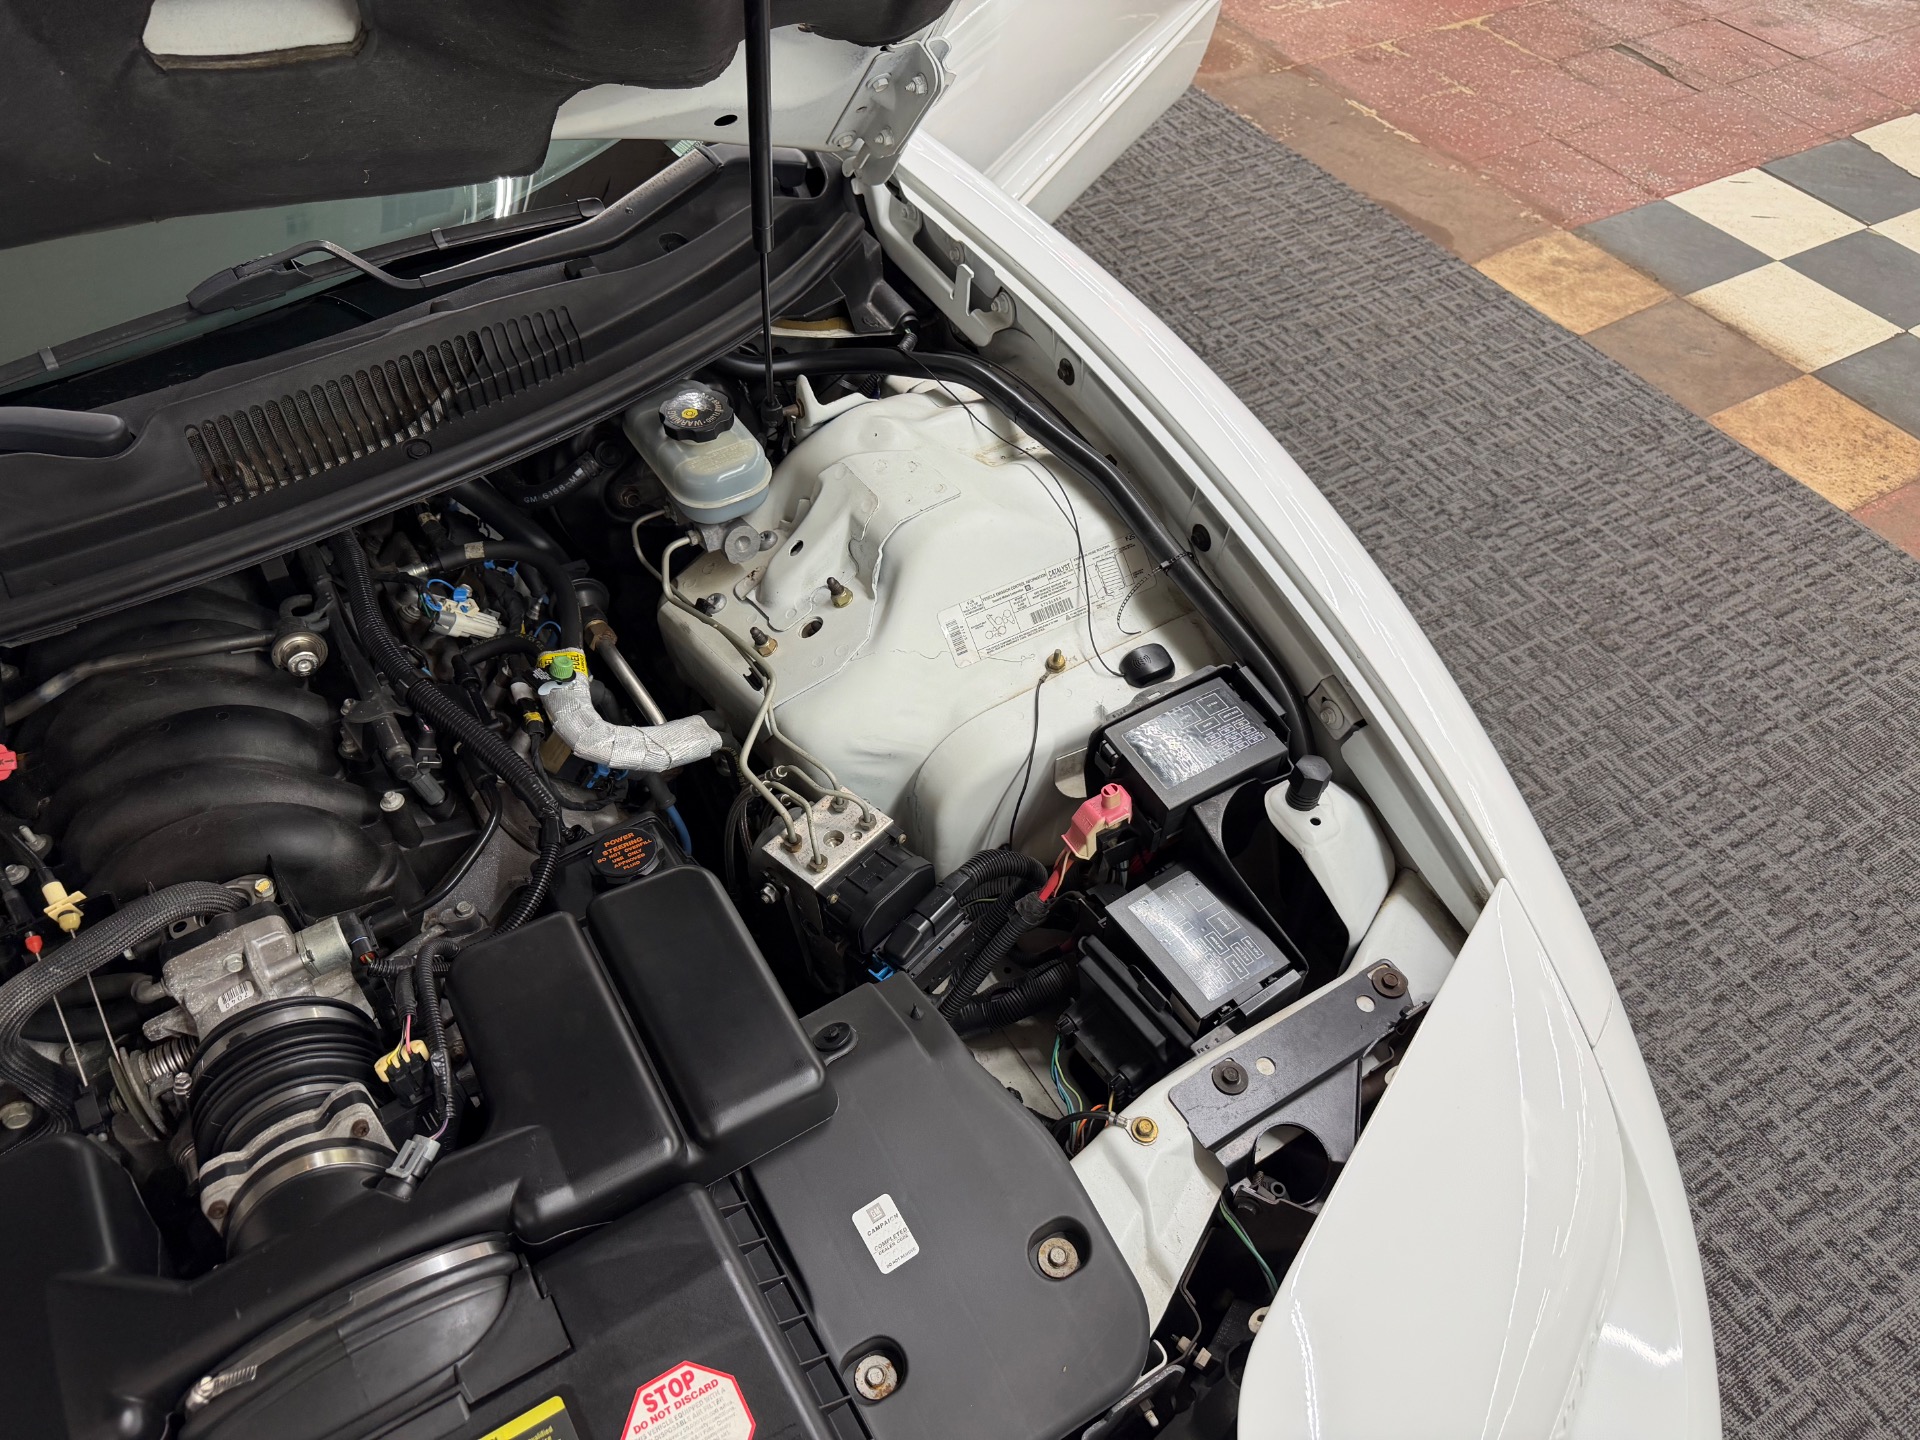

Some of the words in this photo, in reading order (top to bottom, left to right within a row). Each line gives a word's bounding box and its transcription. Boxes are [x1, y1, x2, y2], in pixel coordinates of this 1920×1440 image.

[668, 410, 704, 427] WARNING
[524, 495, 537, 504] GM
[541, 474, 577, 500] 6188-M
[1048, 563, 1071, 578] CATALYST
[571, 654, 580, 670] FUEL
[602, 836, 643, 856] STEERING
[604, 832, 634, 848] POWER
[624, 839, 652, 853] OVERFILL
[614, 852, 646, 868] APPROVED
[627, 848, 642, 857] ONLY
[623, 861, 640, 870] FLUID
[870, 1207, 880, 1218] GM
[874, 1227, 908, 1252] COMPLETED
[643, 1370, 694, 1413] STOP
[633, 1421, 648, 1434] DO
[650, 1406, 670, 1424] NOT
[674, 1379, 719, 1411] DISCARD
[647, 1418, 674, 1436] VEHICLE
[674, 1400, 704, 1421] EQUIPPED
[704, 1391, 720, 1406] WITH
[654, 1418, 692, 1440] DISPOSABLE
